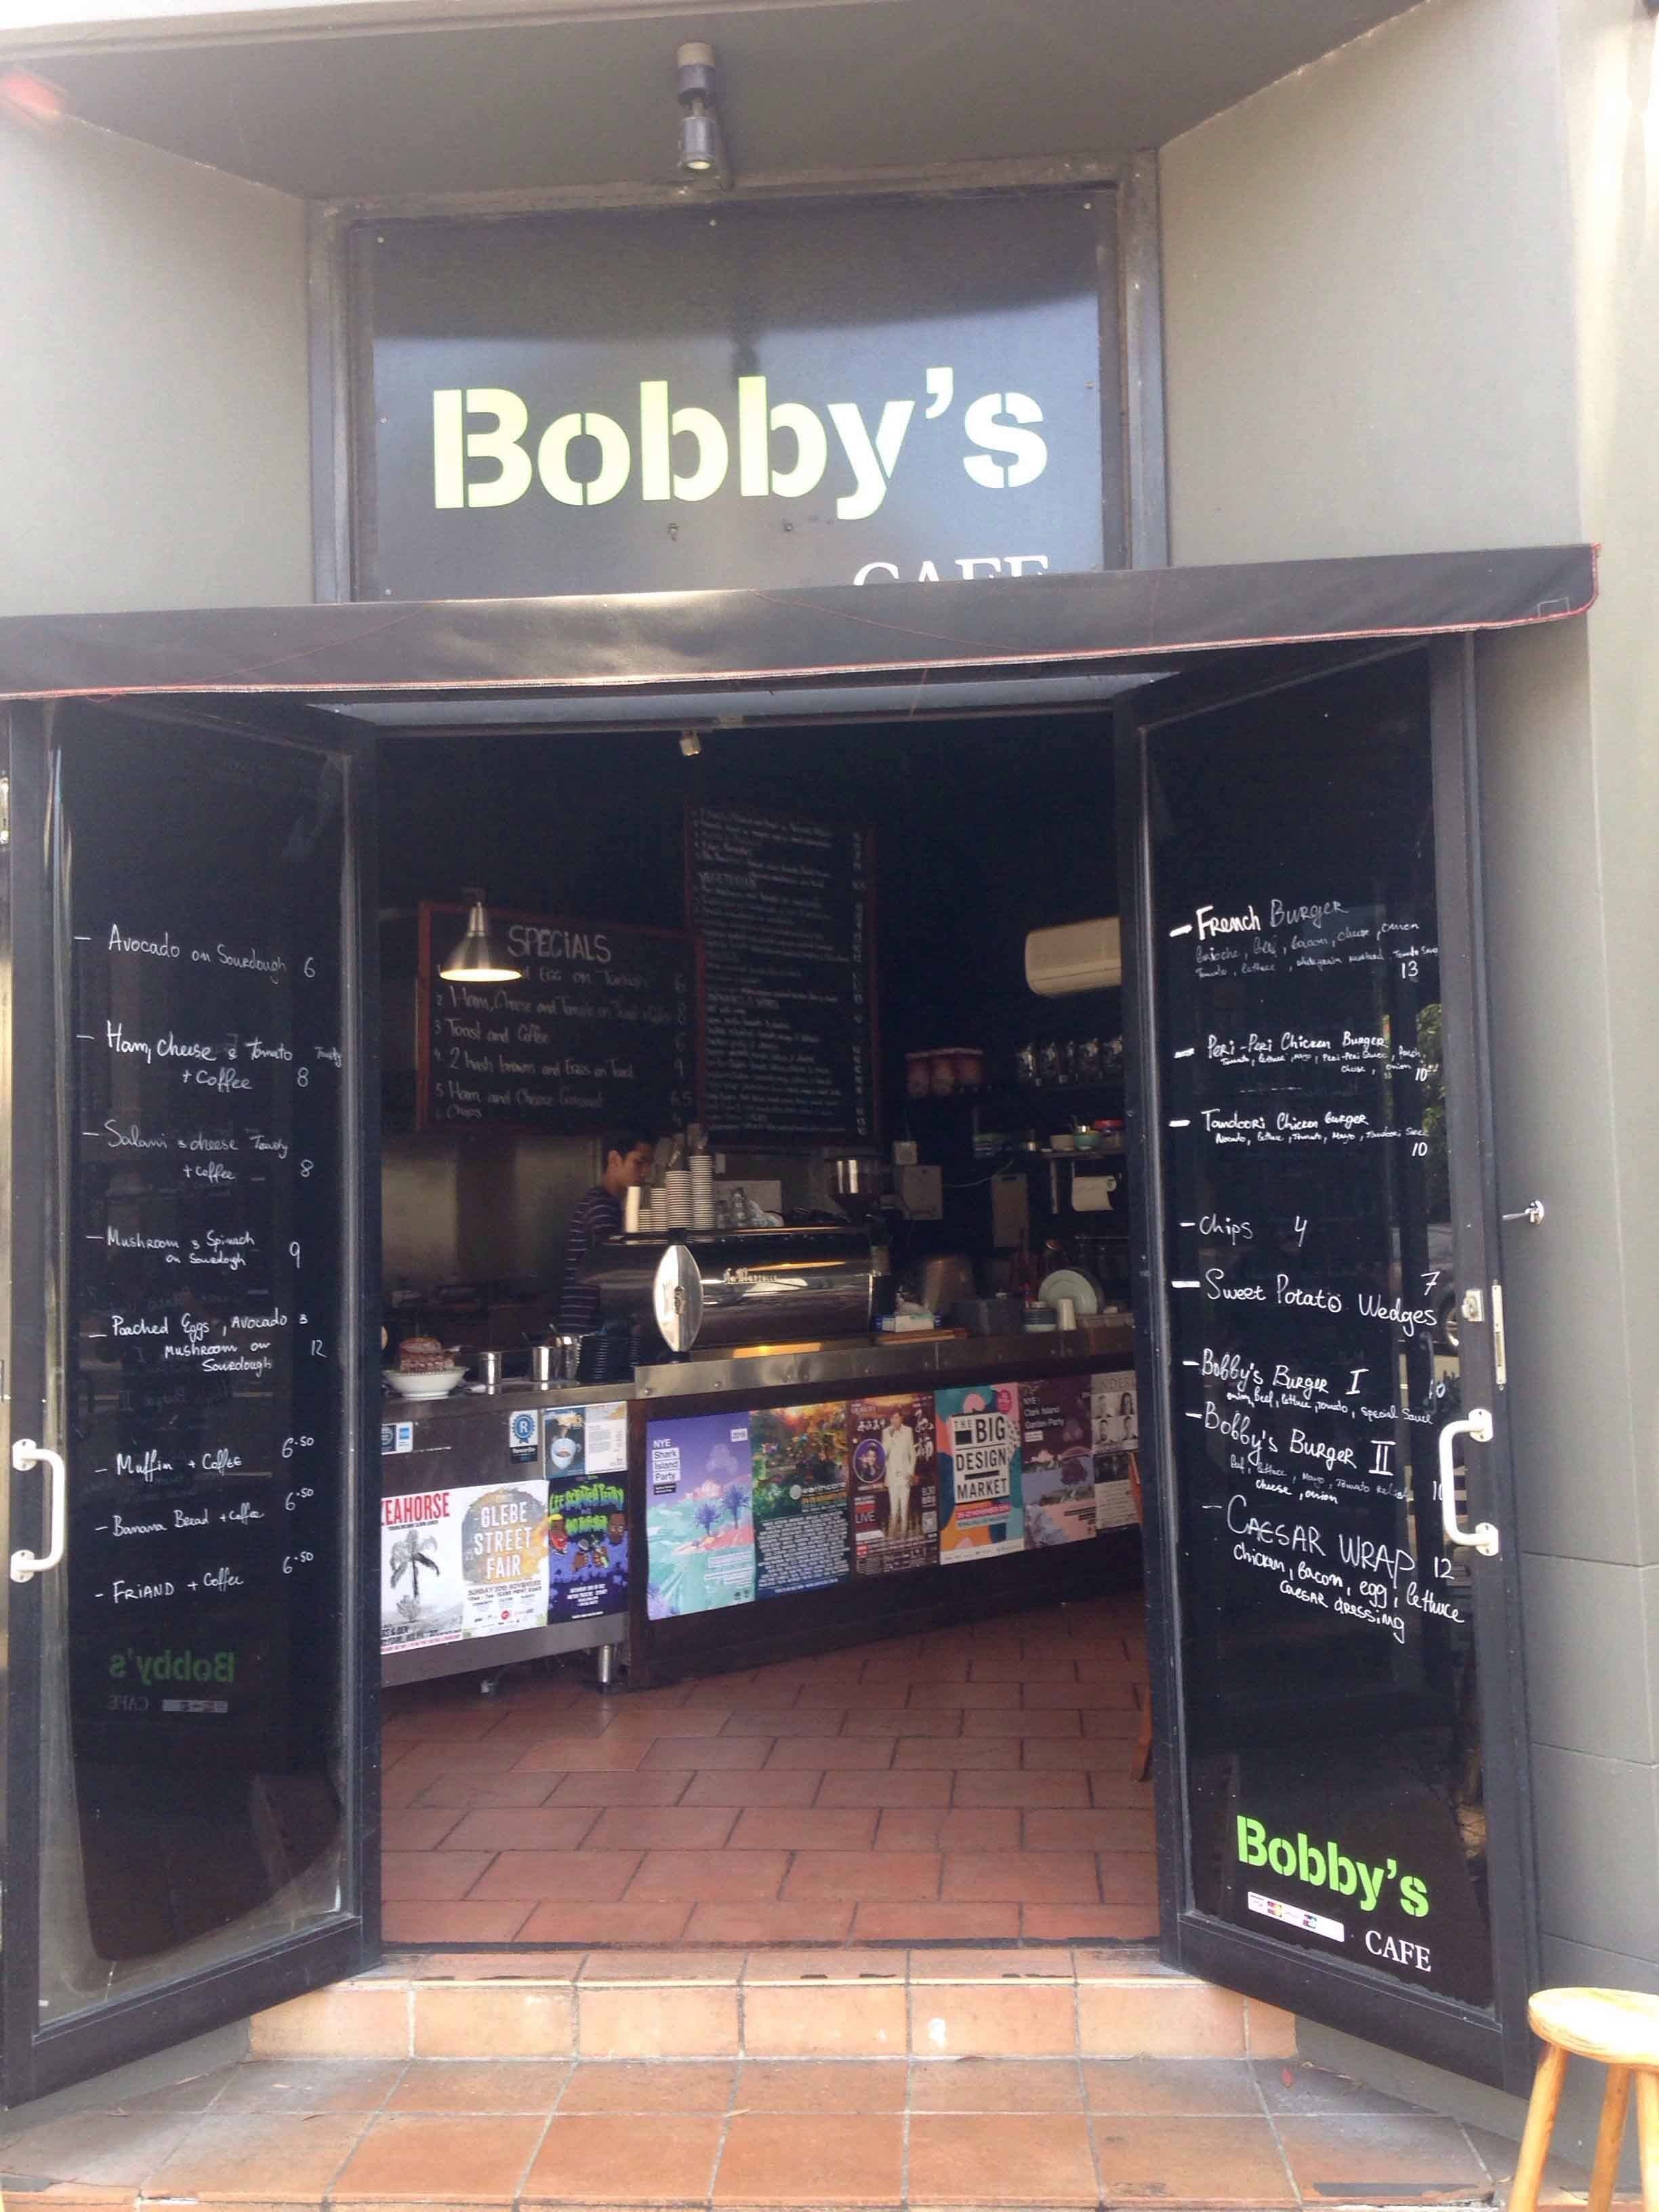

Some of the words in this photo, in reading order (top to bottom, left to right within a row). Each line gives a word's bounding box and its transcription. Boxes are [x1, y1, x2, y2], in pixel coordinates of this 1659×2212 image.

[433, 367, 1047, 520] Bobby's
[1196, 905, 1261, 941] French
[1269, 899, 1350, 928] Burger
[108, 924, 180, 958] Avocado
[192, 950, 211, 962] on
[304, 958, 315, 977] 6
[507, 925, 611, 963] SPECIALS
[1401, 961, 1418, 979] 13
[246, 1038, 292, 1061] Tomato
[1281, 1032, 1331, 1050] Chicken
[1342, 1031, 1388, 1048] Burger
[297, 1067, 309, 1087] 8
[1415, 1067, 1427, 1082] 10
[104, 1119, 167, 1148] Salami
[1201, 1109, 1266, 1132] Tandoori
[1412, 1143, 1427, 1156] 10
[300, 1160, 314, 1177] 8
[107, 1226, 179, 1248] Mushroom
[206, 1230, 254, 1252] Spinach
[1200, 1214, 1252, 1245] Chips
[1294, 1215, 1307, 1247] 4
[166, 1254, 181, 1263] on
[289, 1242, 301, 1268] 9
[1205, 1268, 1266, 1300] Sweet
[1277, 1274, 1341, 1313] Potato
[1359, 1294, 1437, 1336] Wedges
[1420, 1271, 1441, 1295] 7
[112, 1315, 169, 1336] Poached
[250, 1342, 270, 1351] on
[312, 1340, 327, 1357] 12
[1202, 1348, 1264, 1391] Bobby's
[1273, 1364, 1328, 1400] Burger
[1345, 1368, 1369, 1395] I
[954, 1419, 972, 1429] THE
[975, 1416, 1006, 1443] BIG
[1205, 1401, 1278, 1465] Bobby's
[1290, 1429, 1357, 1469] Burger
[1369, 1440, 1396, 1476] II
[117, 1449, 173, 1482] Muffin
[655, 1451, 677, 1459] Shark
[956, 1448, 1007, 1471] DESIGN
[655, 1473, 676, 1482] Party
[957, 1478, 1007, 1500] MARKET
[382, 1492, 450, 1526] EAHORSE
[480, 1502, 528, 1528] GLEBE
[112, 1515, 167, 1536] Banana
[173, 1509, 209, 1528] Bread
[474, 1528, 531, 1555] STREET
[1227, 1495, 1326, 1556] CAESAR
[1339, 1534, 1415, 1589] WRAP
[1435, 1557, 1454, 1579] 12
[486, 1555, 521, 1578] FAIR
[1237, 1816, 1429, 1917] Bobby's
[1365, 1930, 1431, 1972] CAFE
